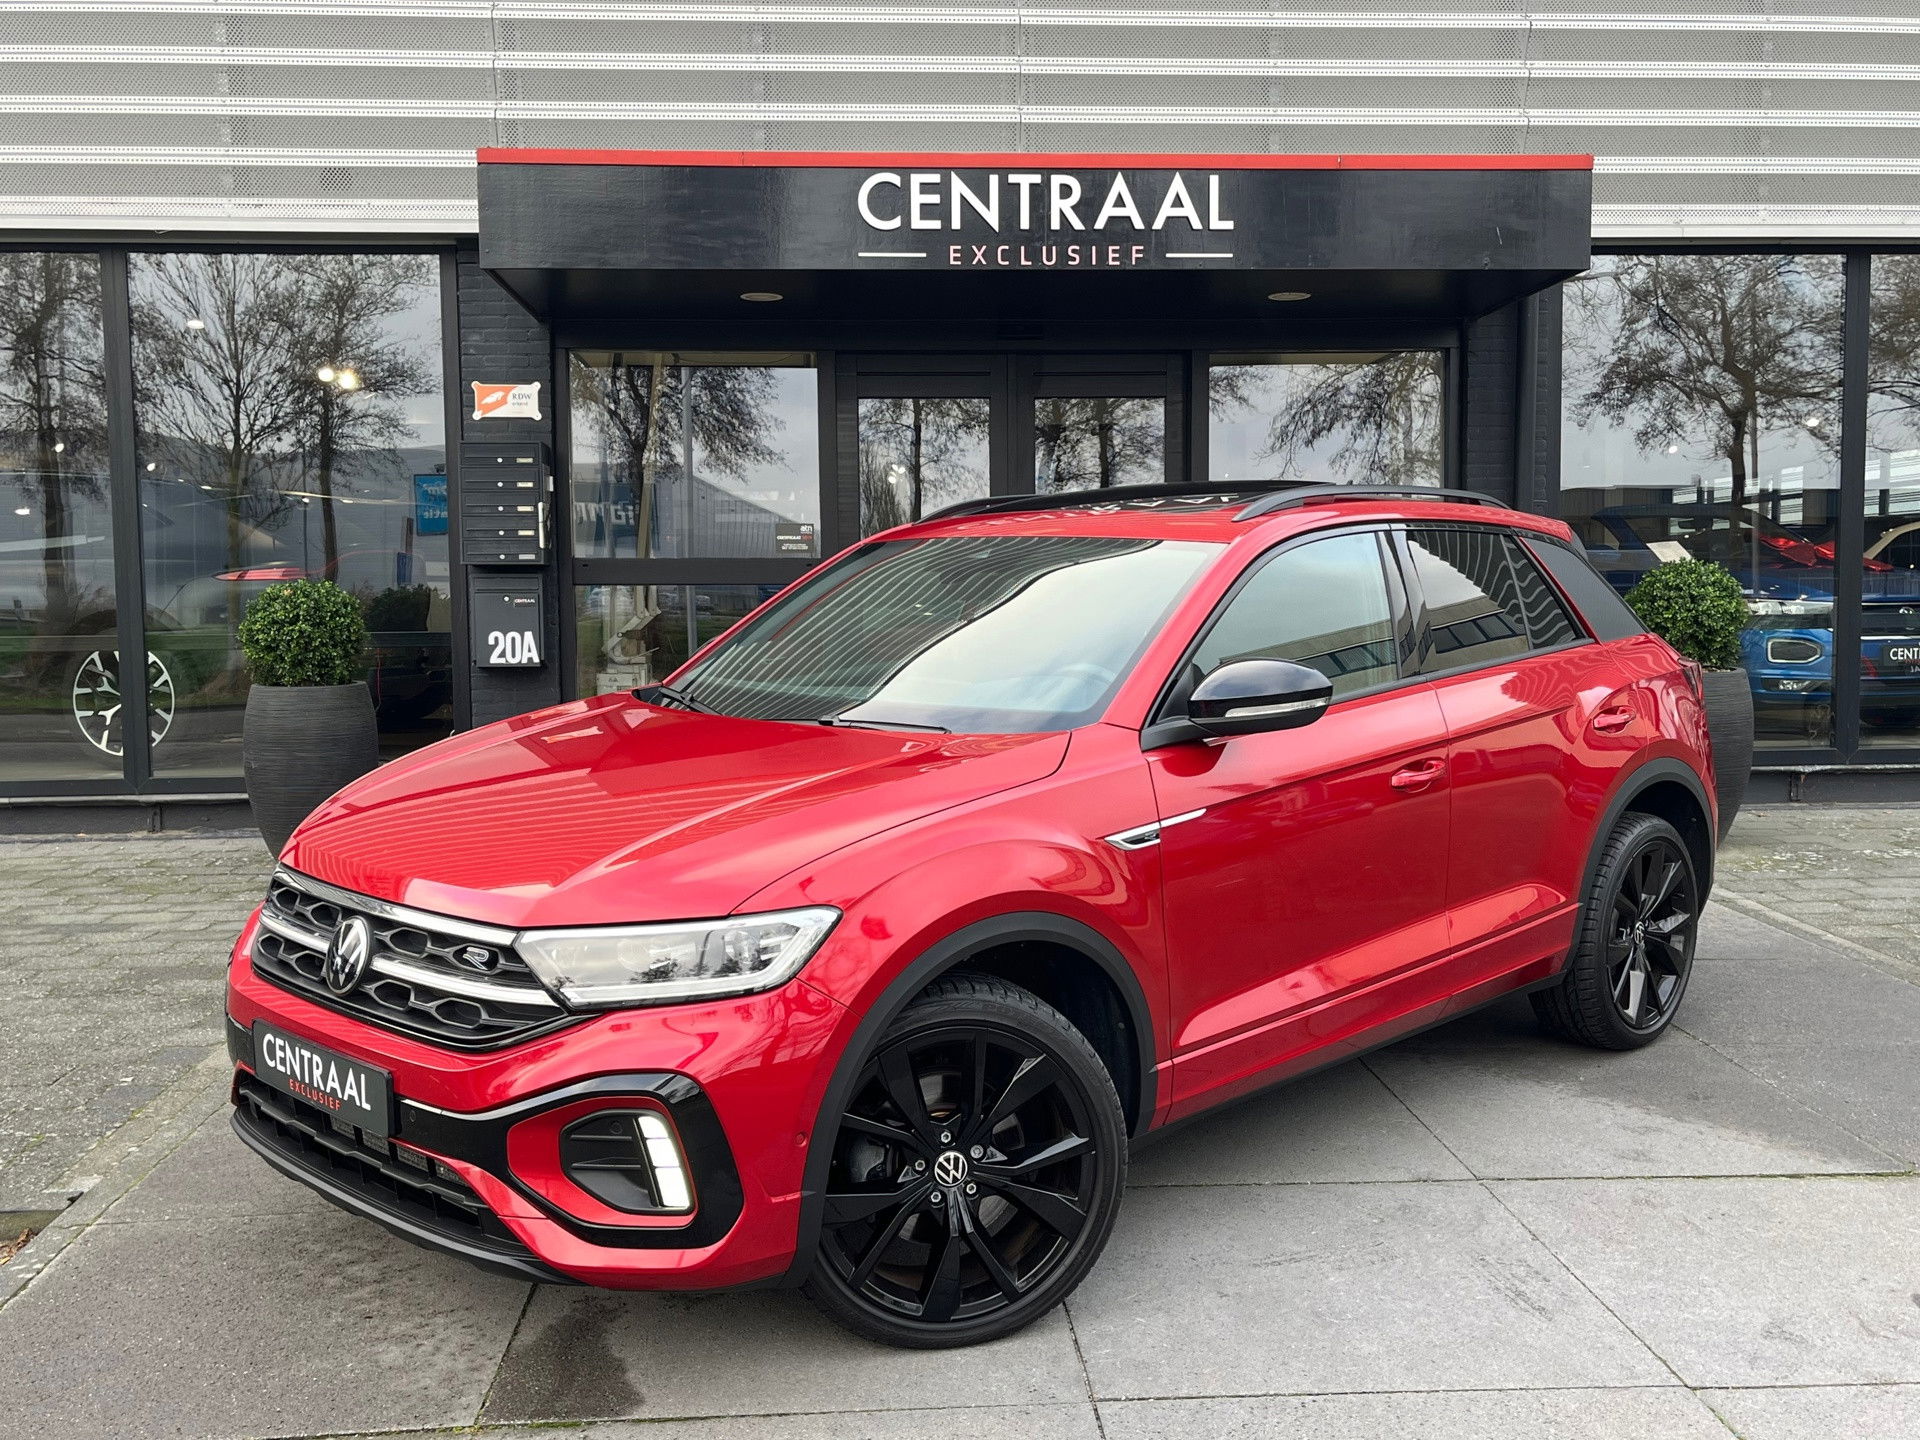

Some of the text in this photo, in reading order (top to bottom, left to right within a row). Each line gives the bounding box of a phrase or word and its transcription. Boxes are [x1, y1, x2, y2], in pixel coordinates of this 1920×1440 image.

[857, 171, 1235, 233] CENTRAAL
[949, 245, 1145, 266] EXCLUSIEF
[511, 392, 533, 401] RDW
[488, 630, 540, 664] 20A
[1889, 647, 1920, 660] CENT
[263, 1033, 371, 1111] CENTRAAL
[289, 1078, 341, 1110] EXCLUSIEF
